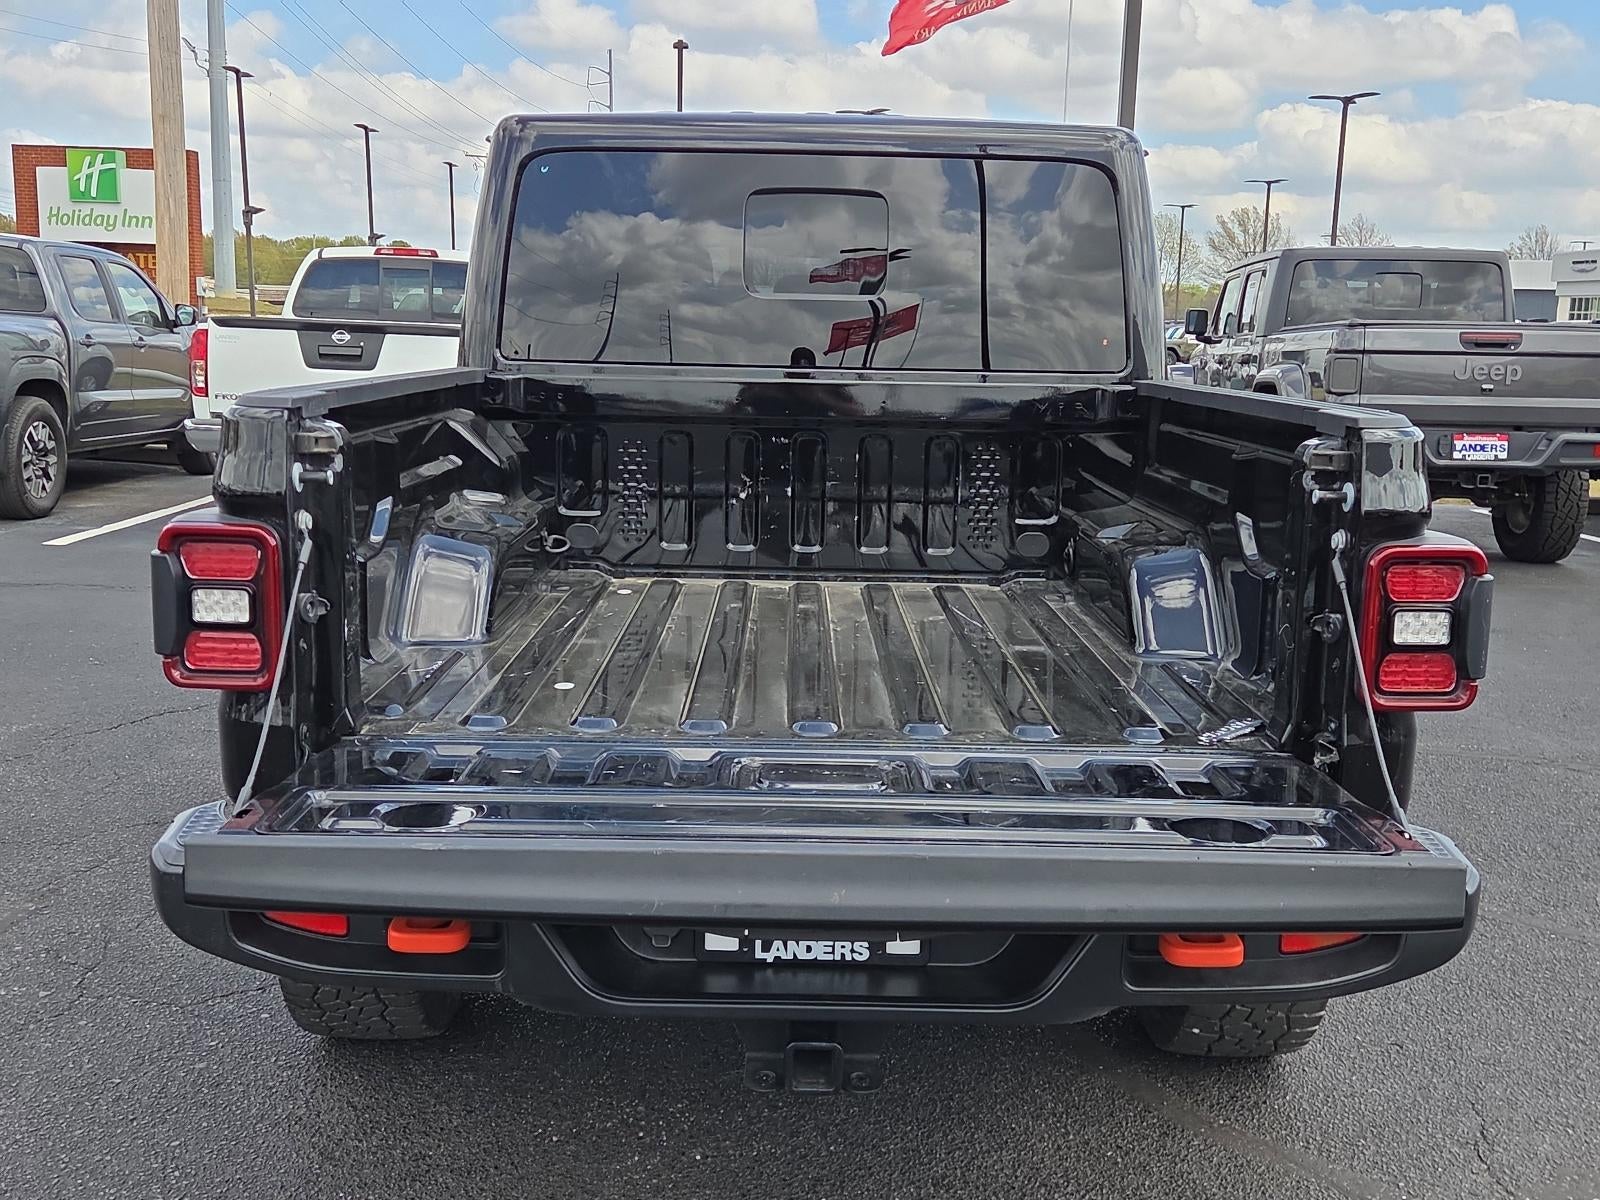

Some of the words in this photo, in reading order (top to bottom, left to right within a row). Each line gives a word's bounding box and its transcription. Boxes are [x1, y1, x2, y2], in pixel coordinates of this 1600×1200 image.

[47, 206, 118, 232] Holiday
[121, 208, 153, 229] Inn
[1453, 359, 1522, 385] Jeep
[215, 393, 242, 401] FRO
[1452, 443, 1507, 453] LANDERS
[754, 939, 870, 962] LANDERS
